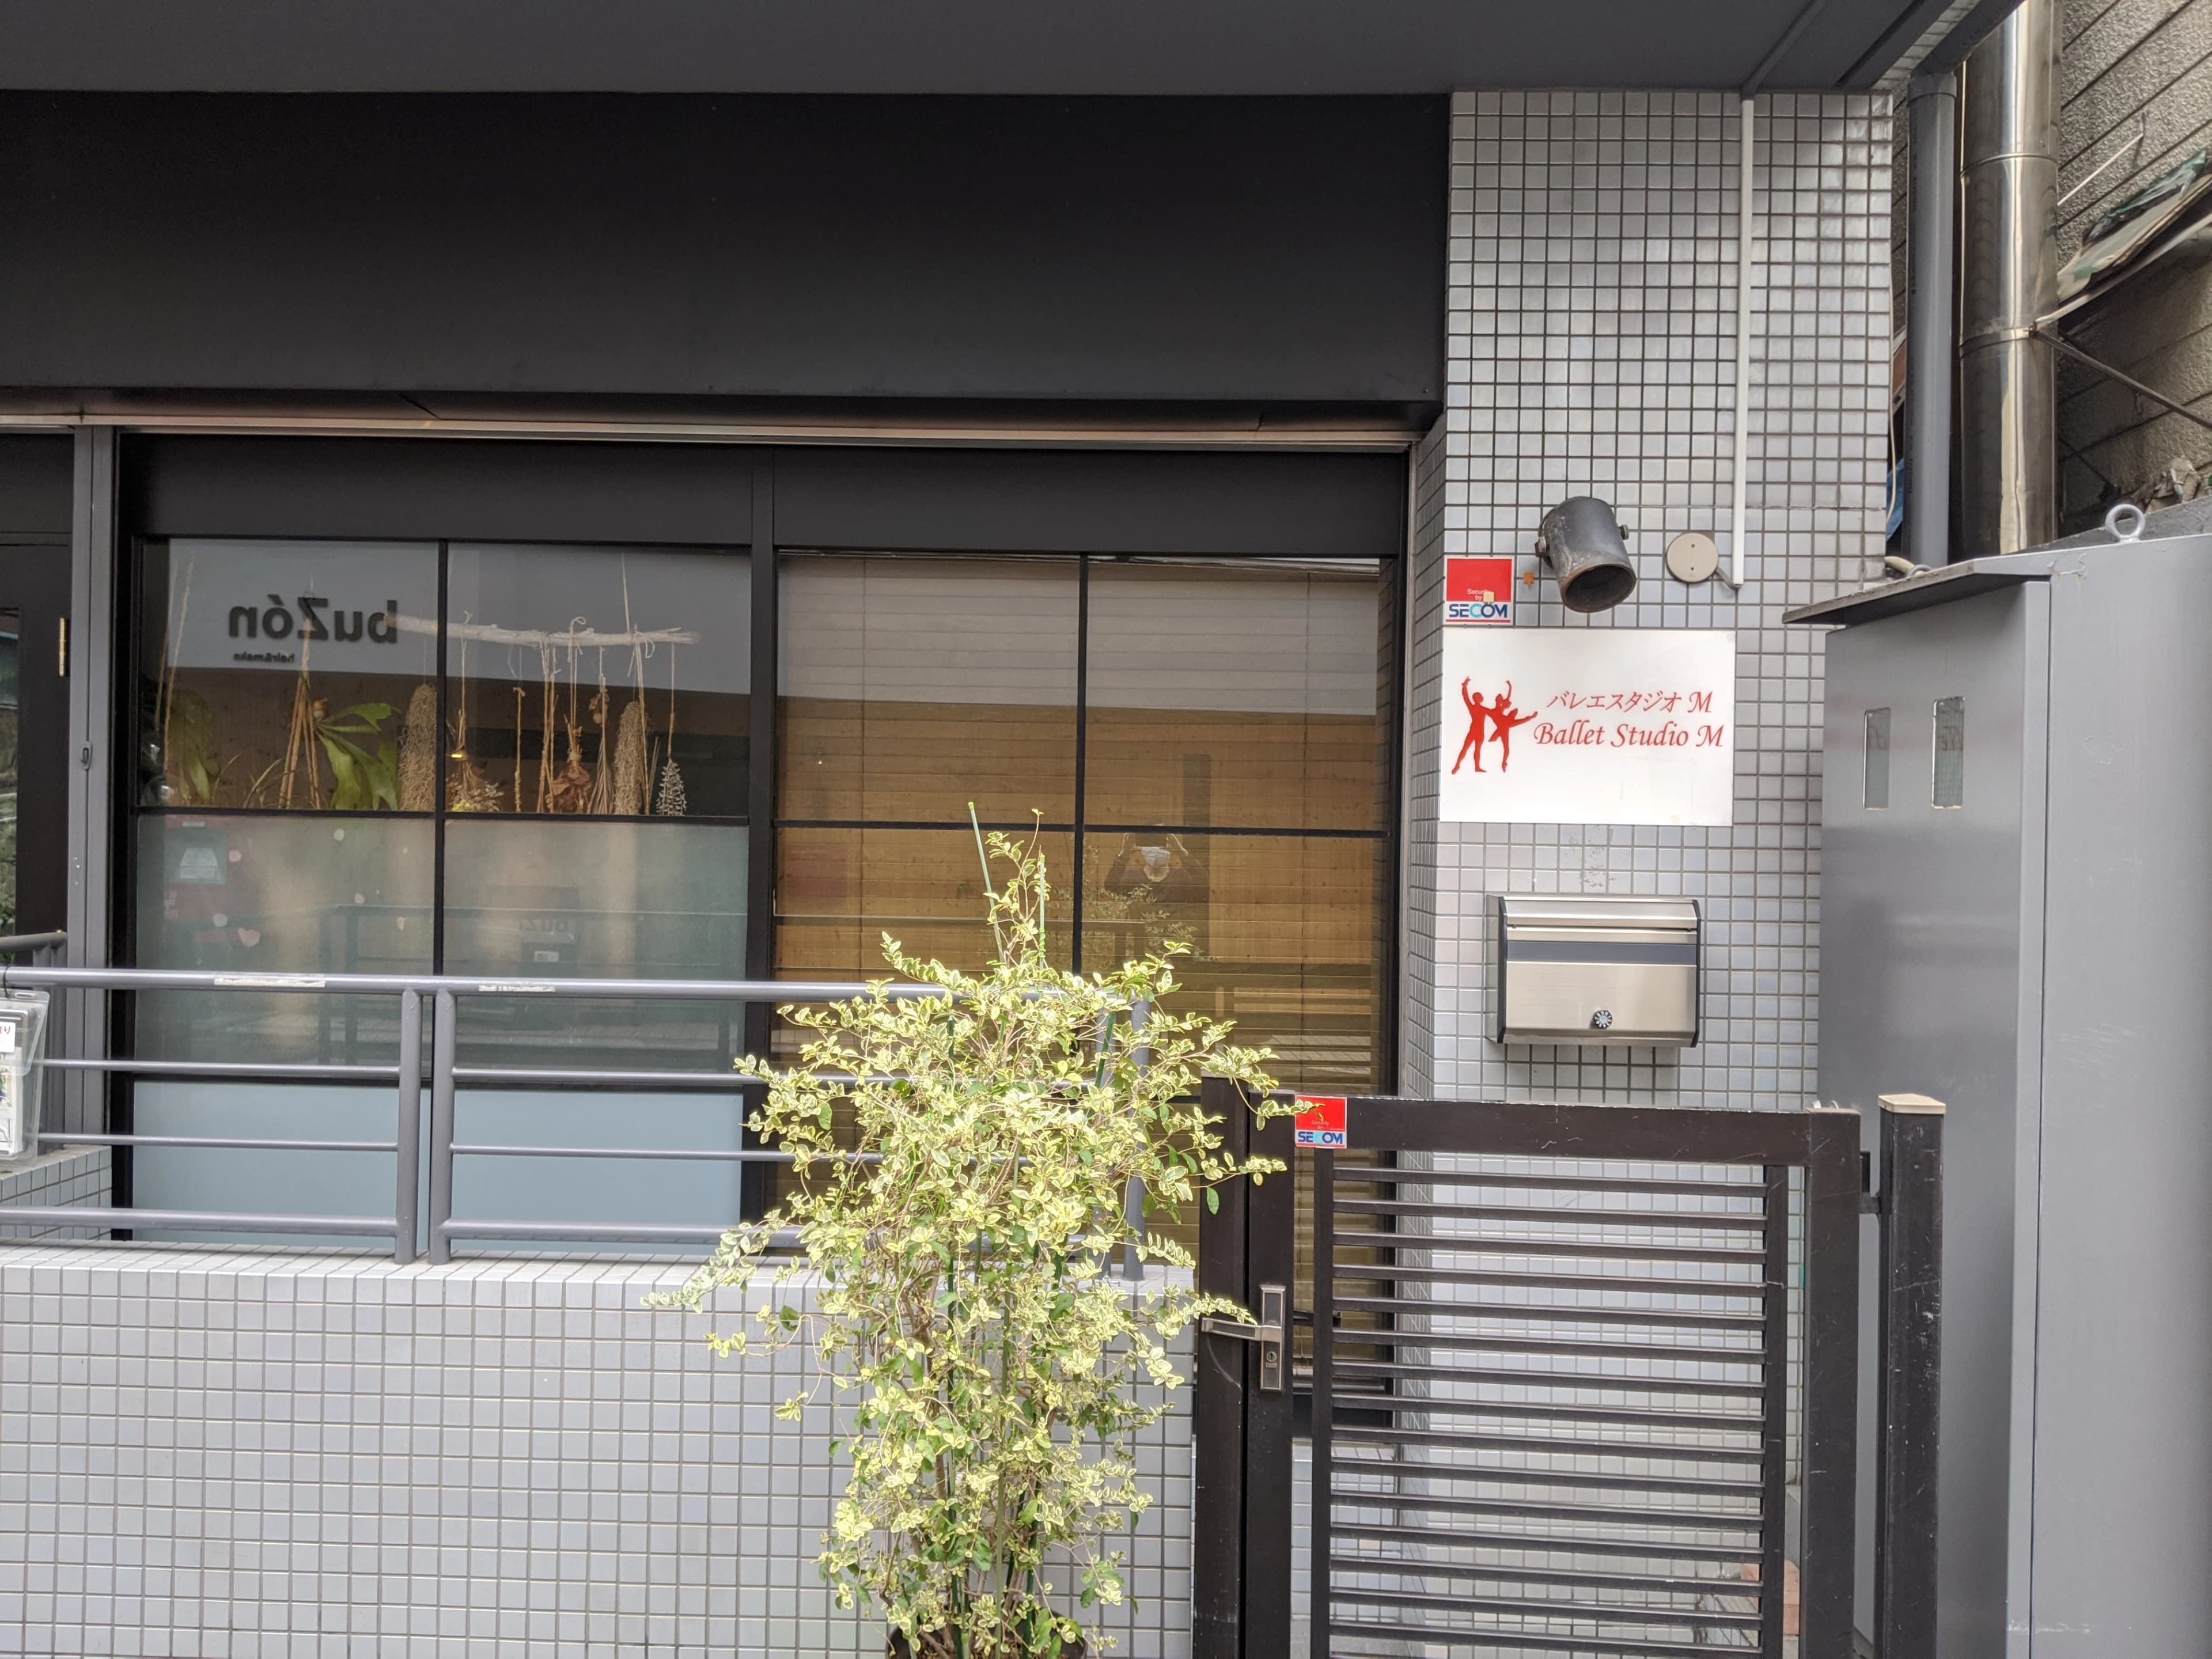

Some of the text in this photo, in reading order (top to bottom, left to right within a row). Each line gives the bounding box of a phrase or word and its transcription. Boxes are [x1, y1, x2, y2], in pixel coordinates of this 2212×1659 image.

[1449, 603, 1508, 619] SECOM
[1546, 690, 1713, 713] バレエスタジオ M
[1533, 719, 1725, 748] Ballet Studio M
[1298, 1131, 1343, 1145] SECOM
